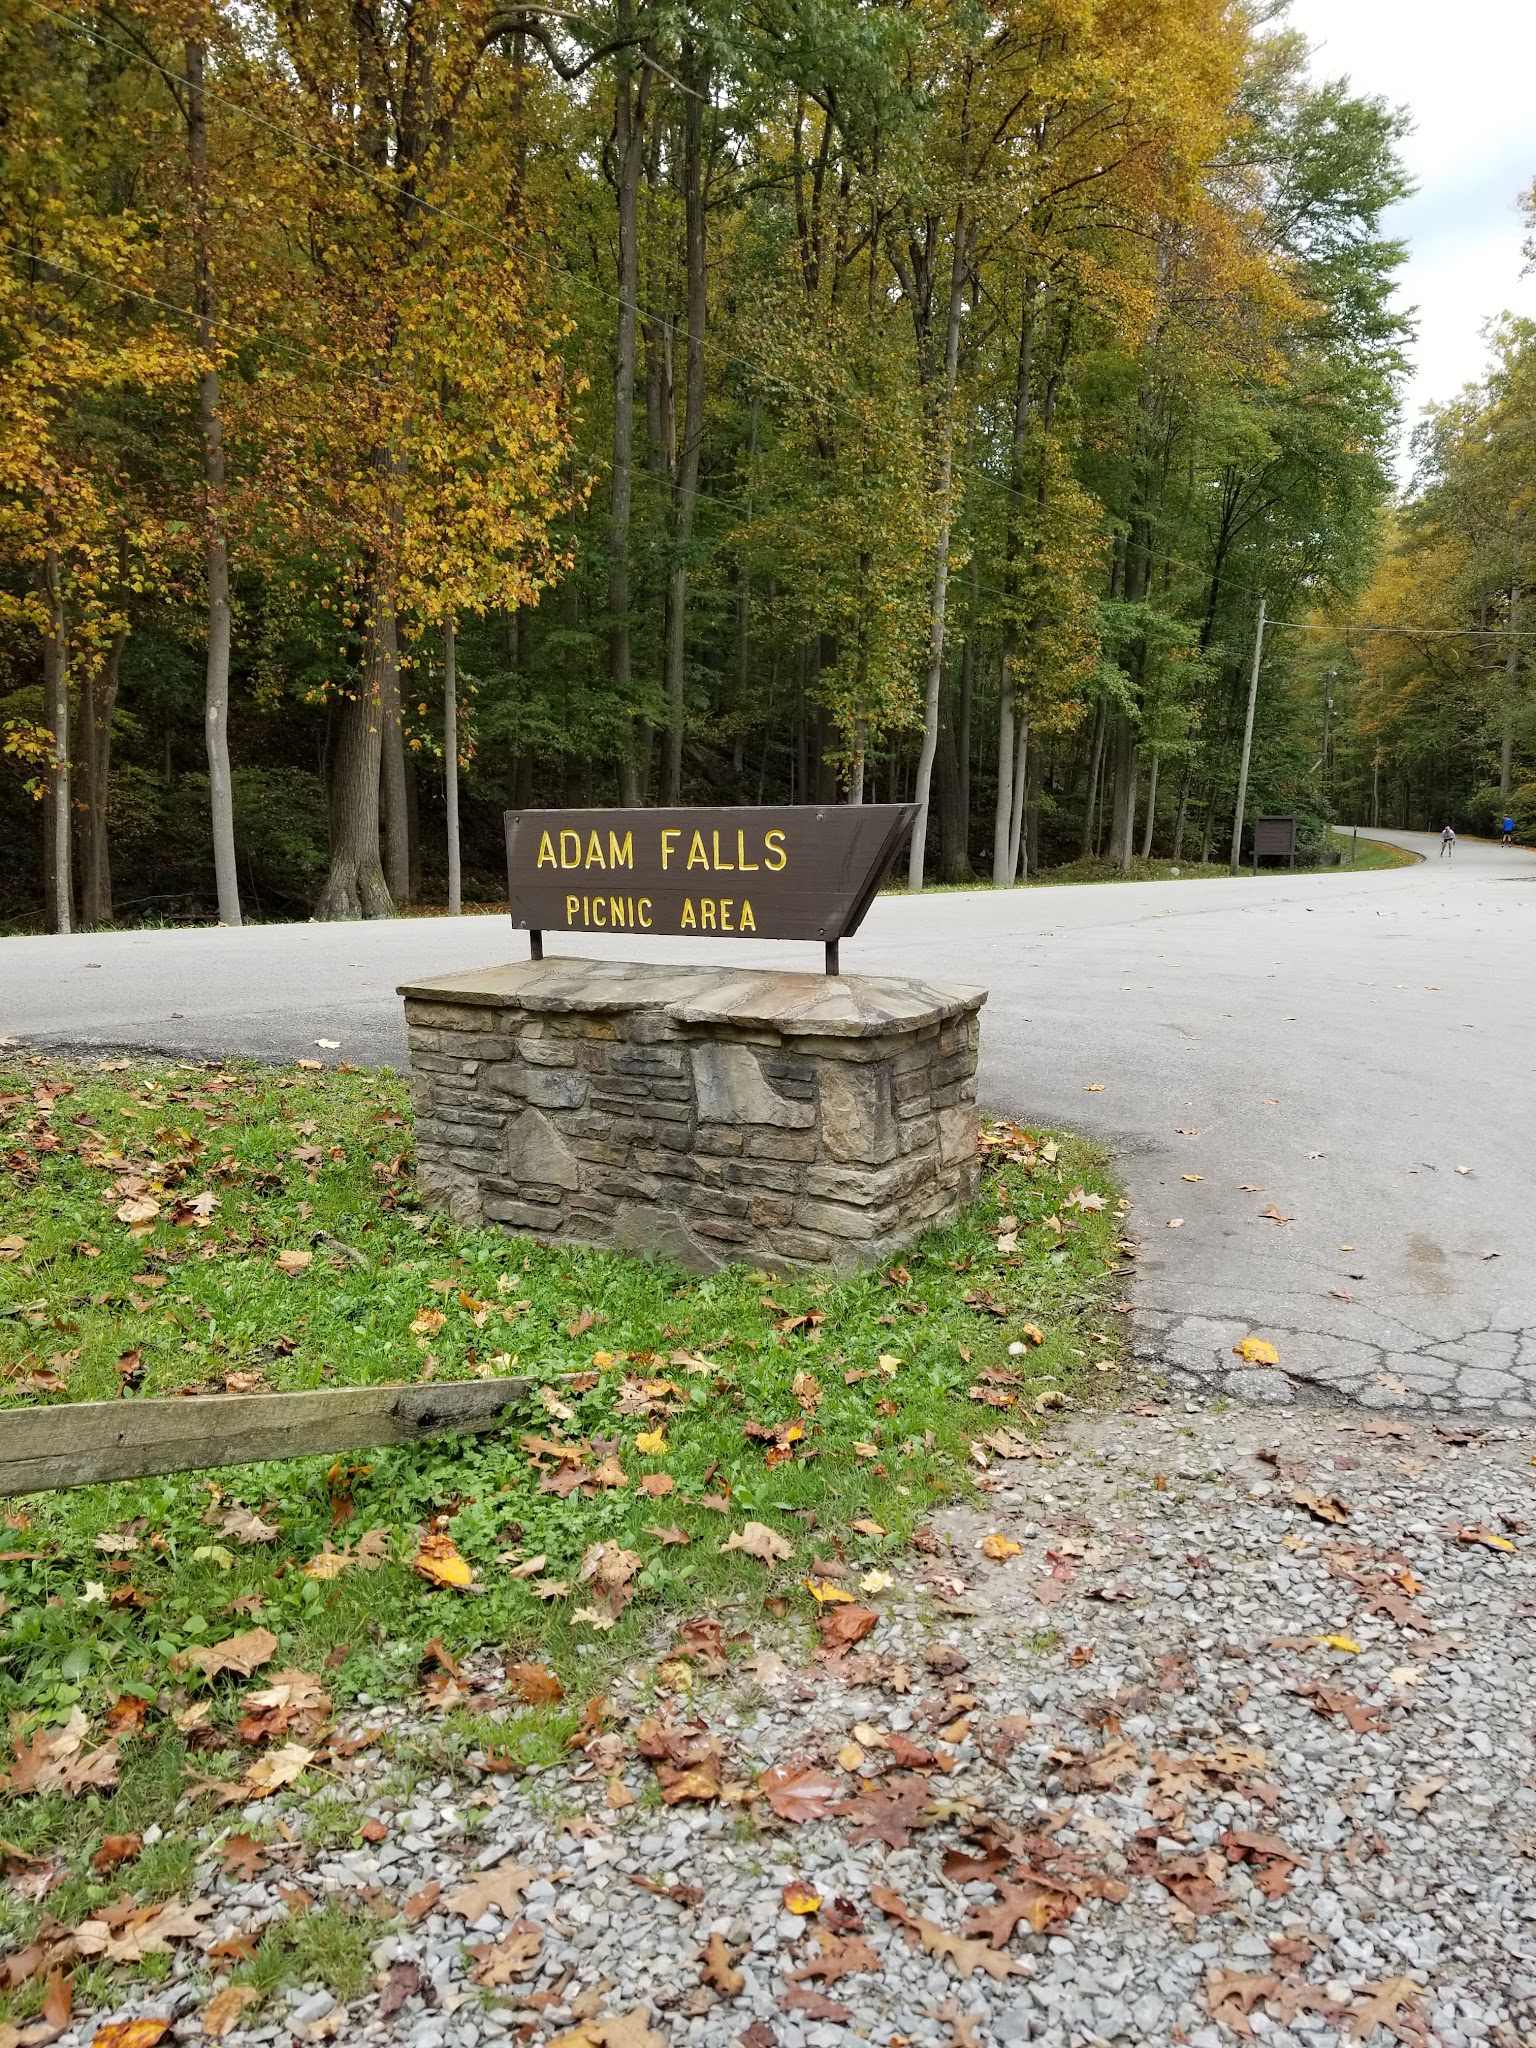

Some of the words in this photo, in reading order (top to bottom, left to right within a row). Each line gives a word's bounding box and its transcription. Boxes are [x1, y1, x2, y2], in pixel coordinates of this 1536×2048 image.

[536, 829, 634, 869] ADAM
[660, 829, 788, 871] FALLS
[565, 894, 653, 928] PICNIC
[680, 897, 757, 931] AREA
